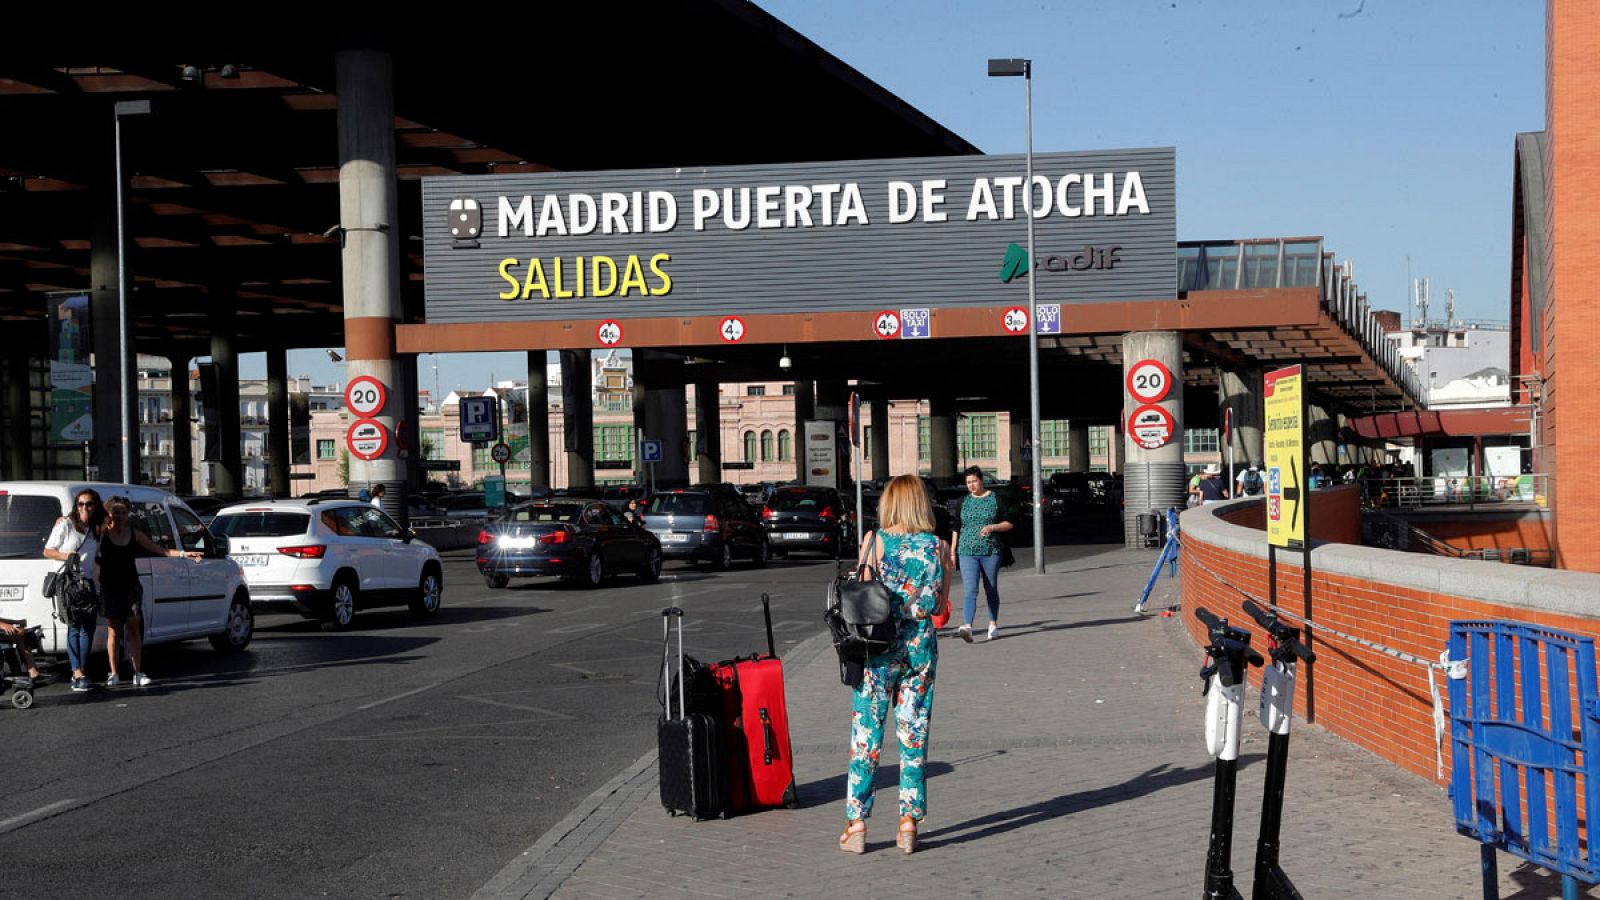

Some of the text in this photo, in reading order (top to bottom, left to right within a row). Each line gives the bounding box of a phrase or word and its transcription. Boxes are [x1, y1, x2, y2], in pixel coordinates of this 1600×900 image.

[498, 171, 1151, 237] MADRID PUERTA DE ATOCHA
[1042, 245, 1121, 271] adif
[498, 253, 673, 301] SALIDAS
[903, 311, 928, 320] SOLO
[906, 319, 926, 327] TAXI
[1136, 373, 1161, 389] 20
[353, 390, 377, 404] 20
[467, 402, 485, 424] P
[645, 442, 657, 460] P
